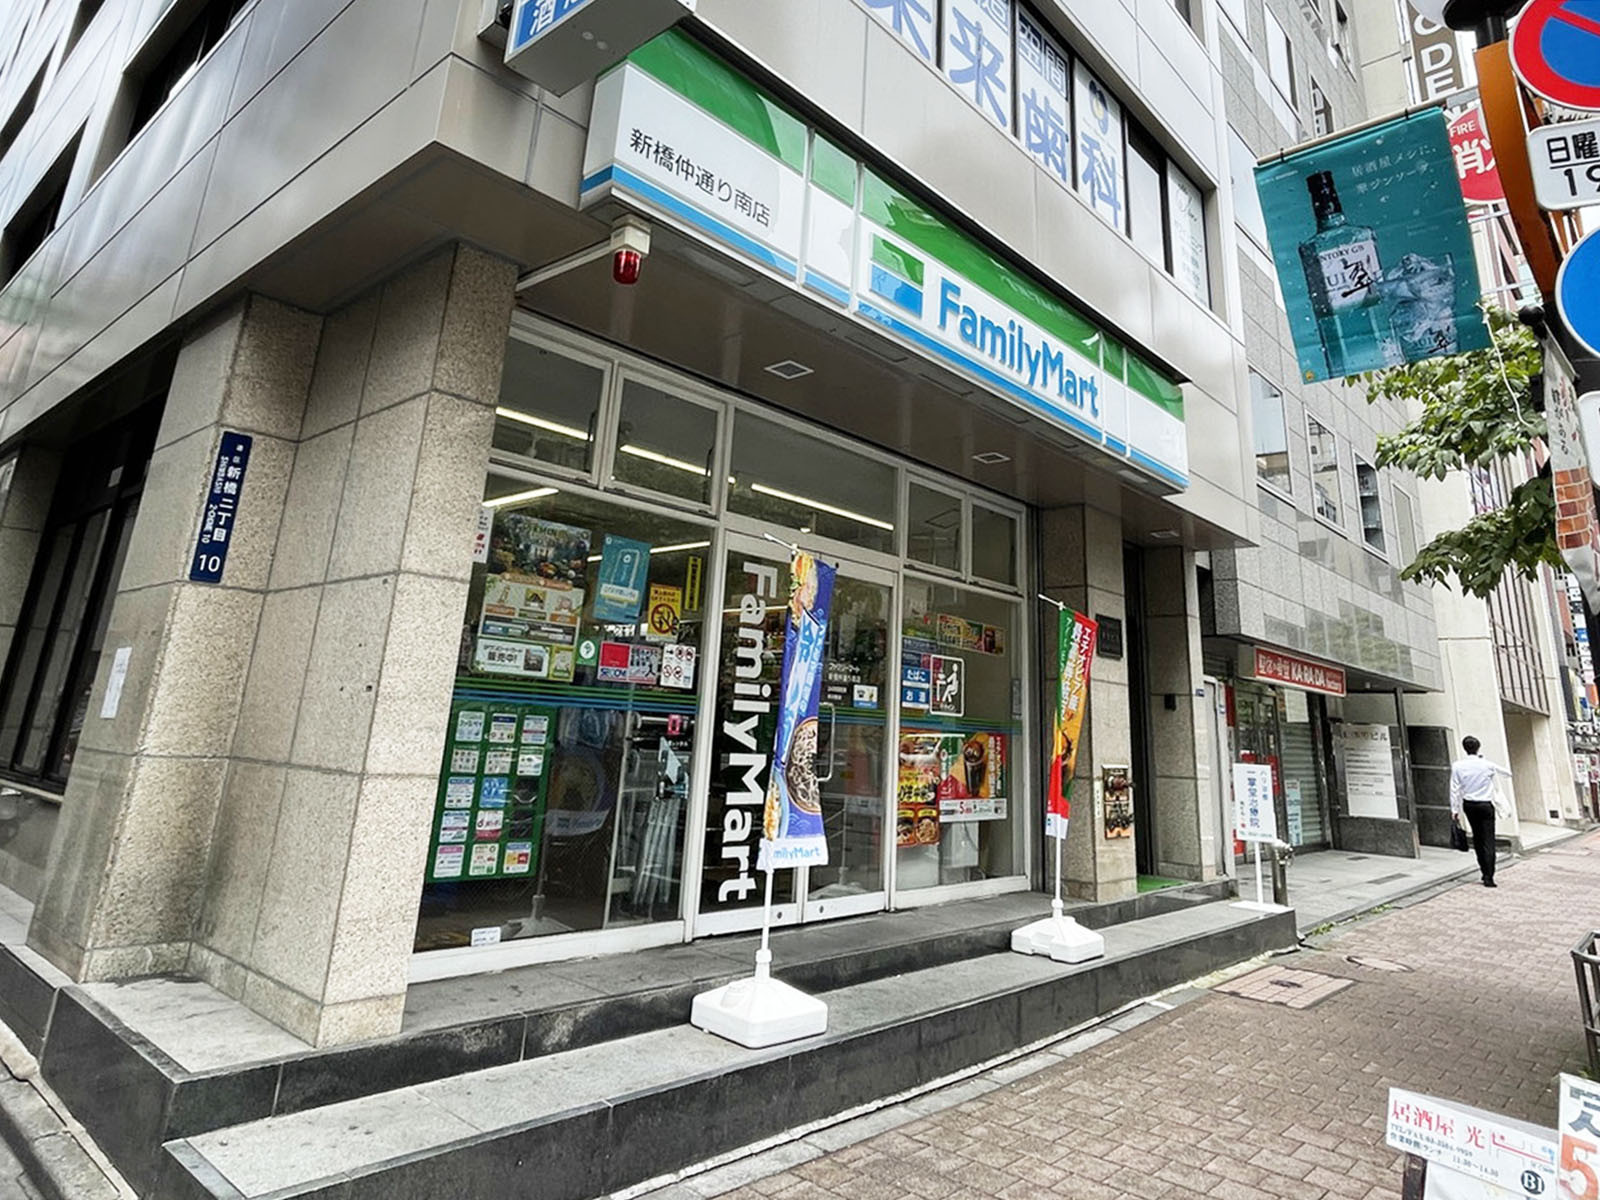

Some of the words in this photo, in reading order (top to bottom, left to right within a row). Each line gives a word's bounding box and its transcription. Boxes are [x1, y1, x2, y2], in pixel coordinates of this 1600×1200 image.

[1450, 119, 1476, 138] FIRE
[629, 127, 771, 228] 新橋仲通り南店
[938, 276, 1099, 417] FamilyMart
[213, 466, 242, 542] 新橋二丁目
[199, 554, 221, 572] 10
[718, 561, 778, 903] FamilyMart
[1391, 1099, 1454, 1139] 居酒屋
